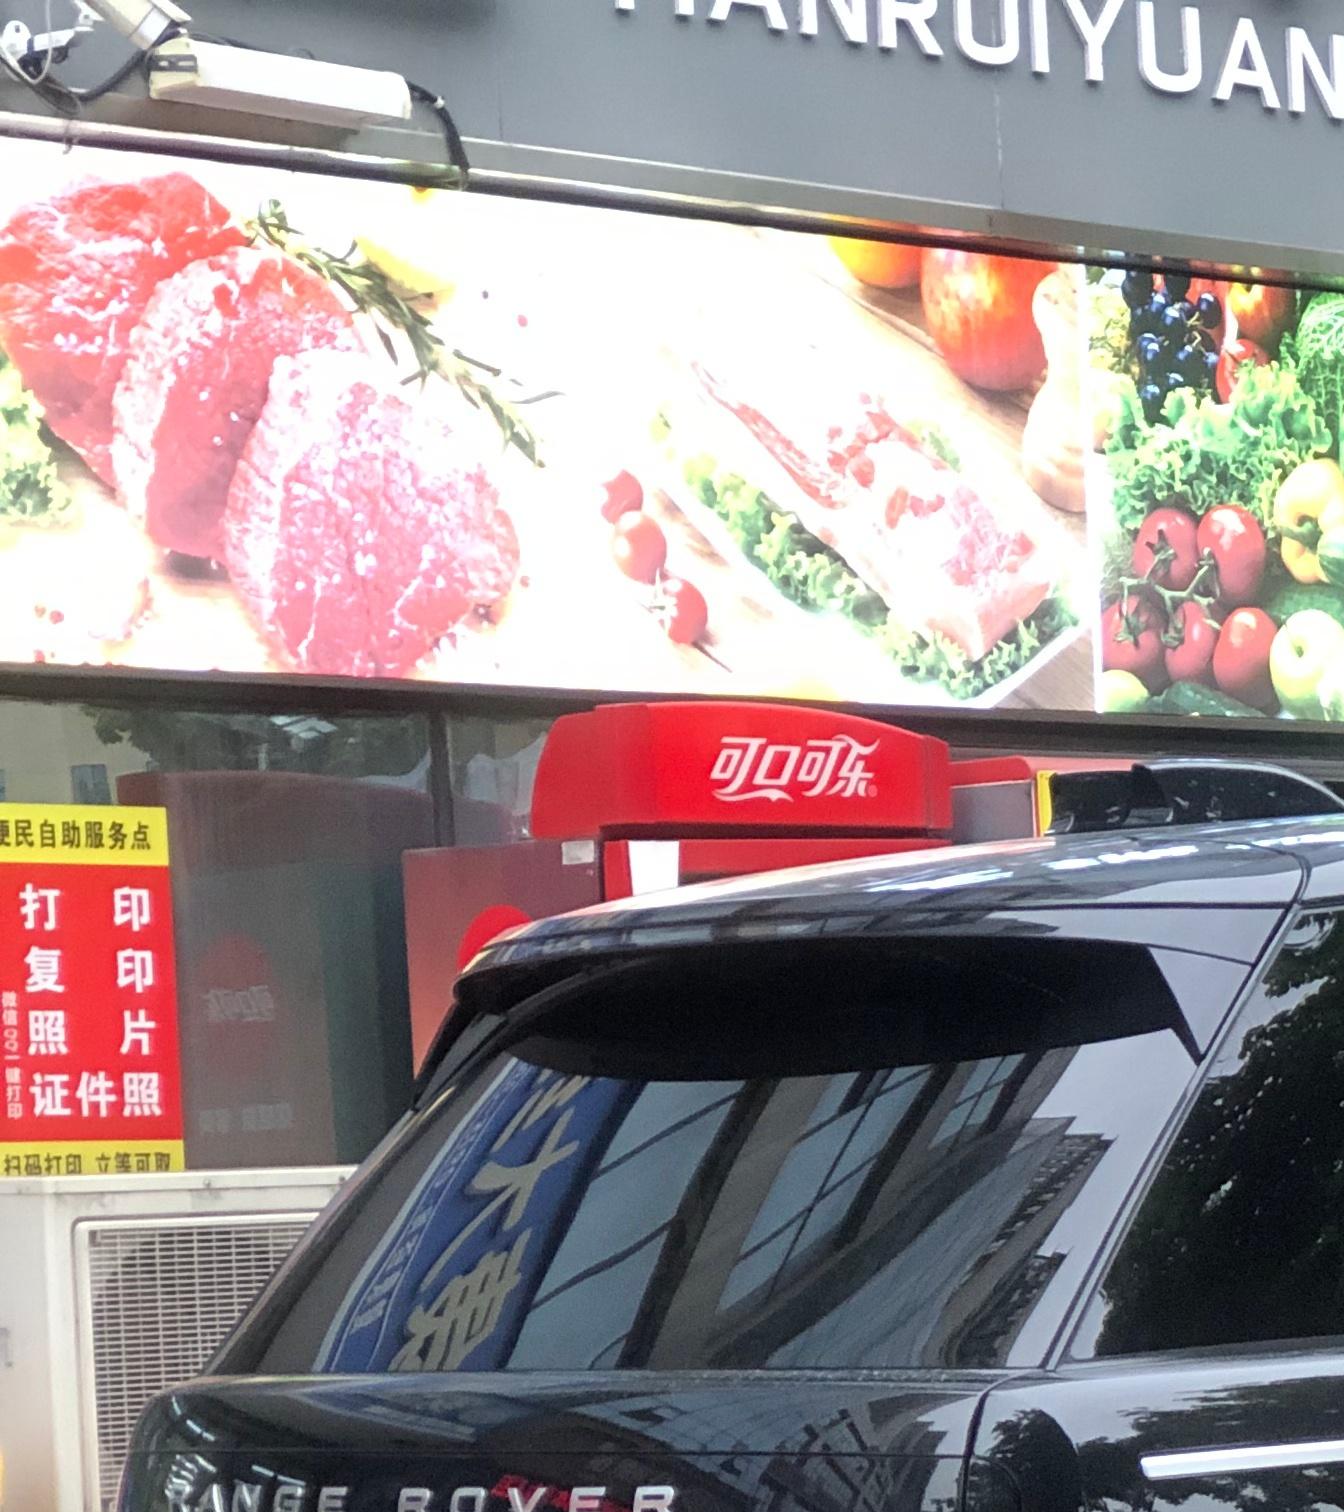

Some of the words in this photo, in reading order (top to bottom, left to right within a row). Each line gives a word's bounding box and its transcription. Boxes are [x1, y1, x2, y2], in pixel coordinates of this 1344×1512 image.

[709, 734, 880, 803] 可口可乐
[29, 1070, 163, 1118] 证件照
[4, 1153, 82, 1177] 扫码打印
[96, 1151, 171, 1174] 立等可取
